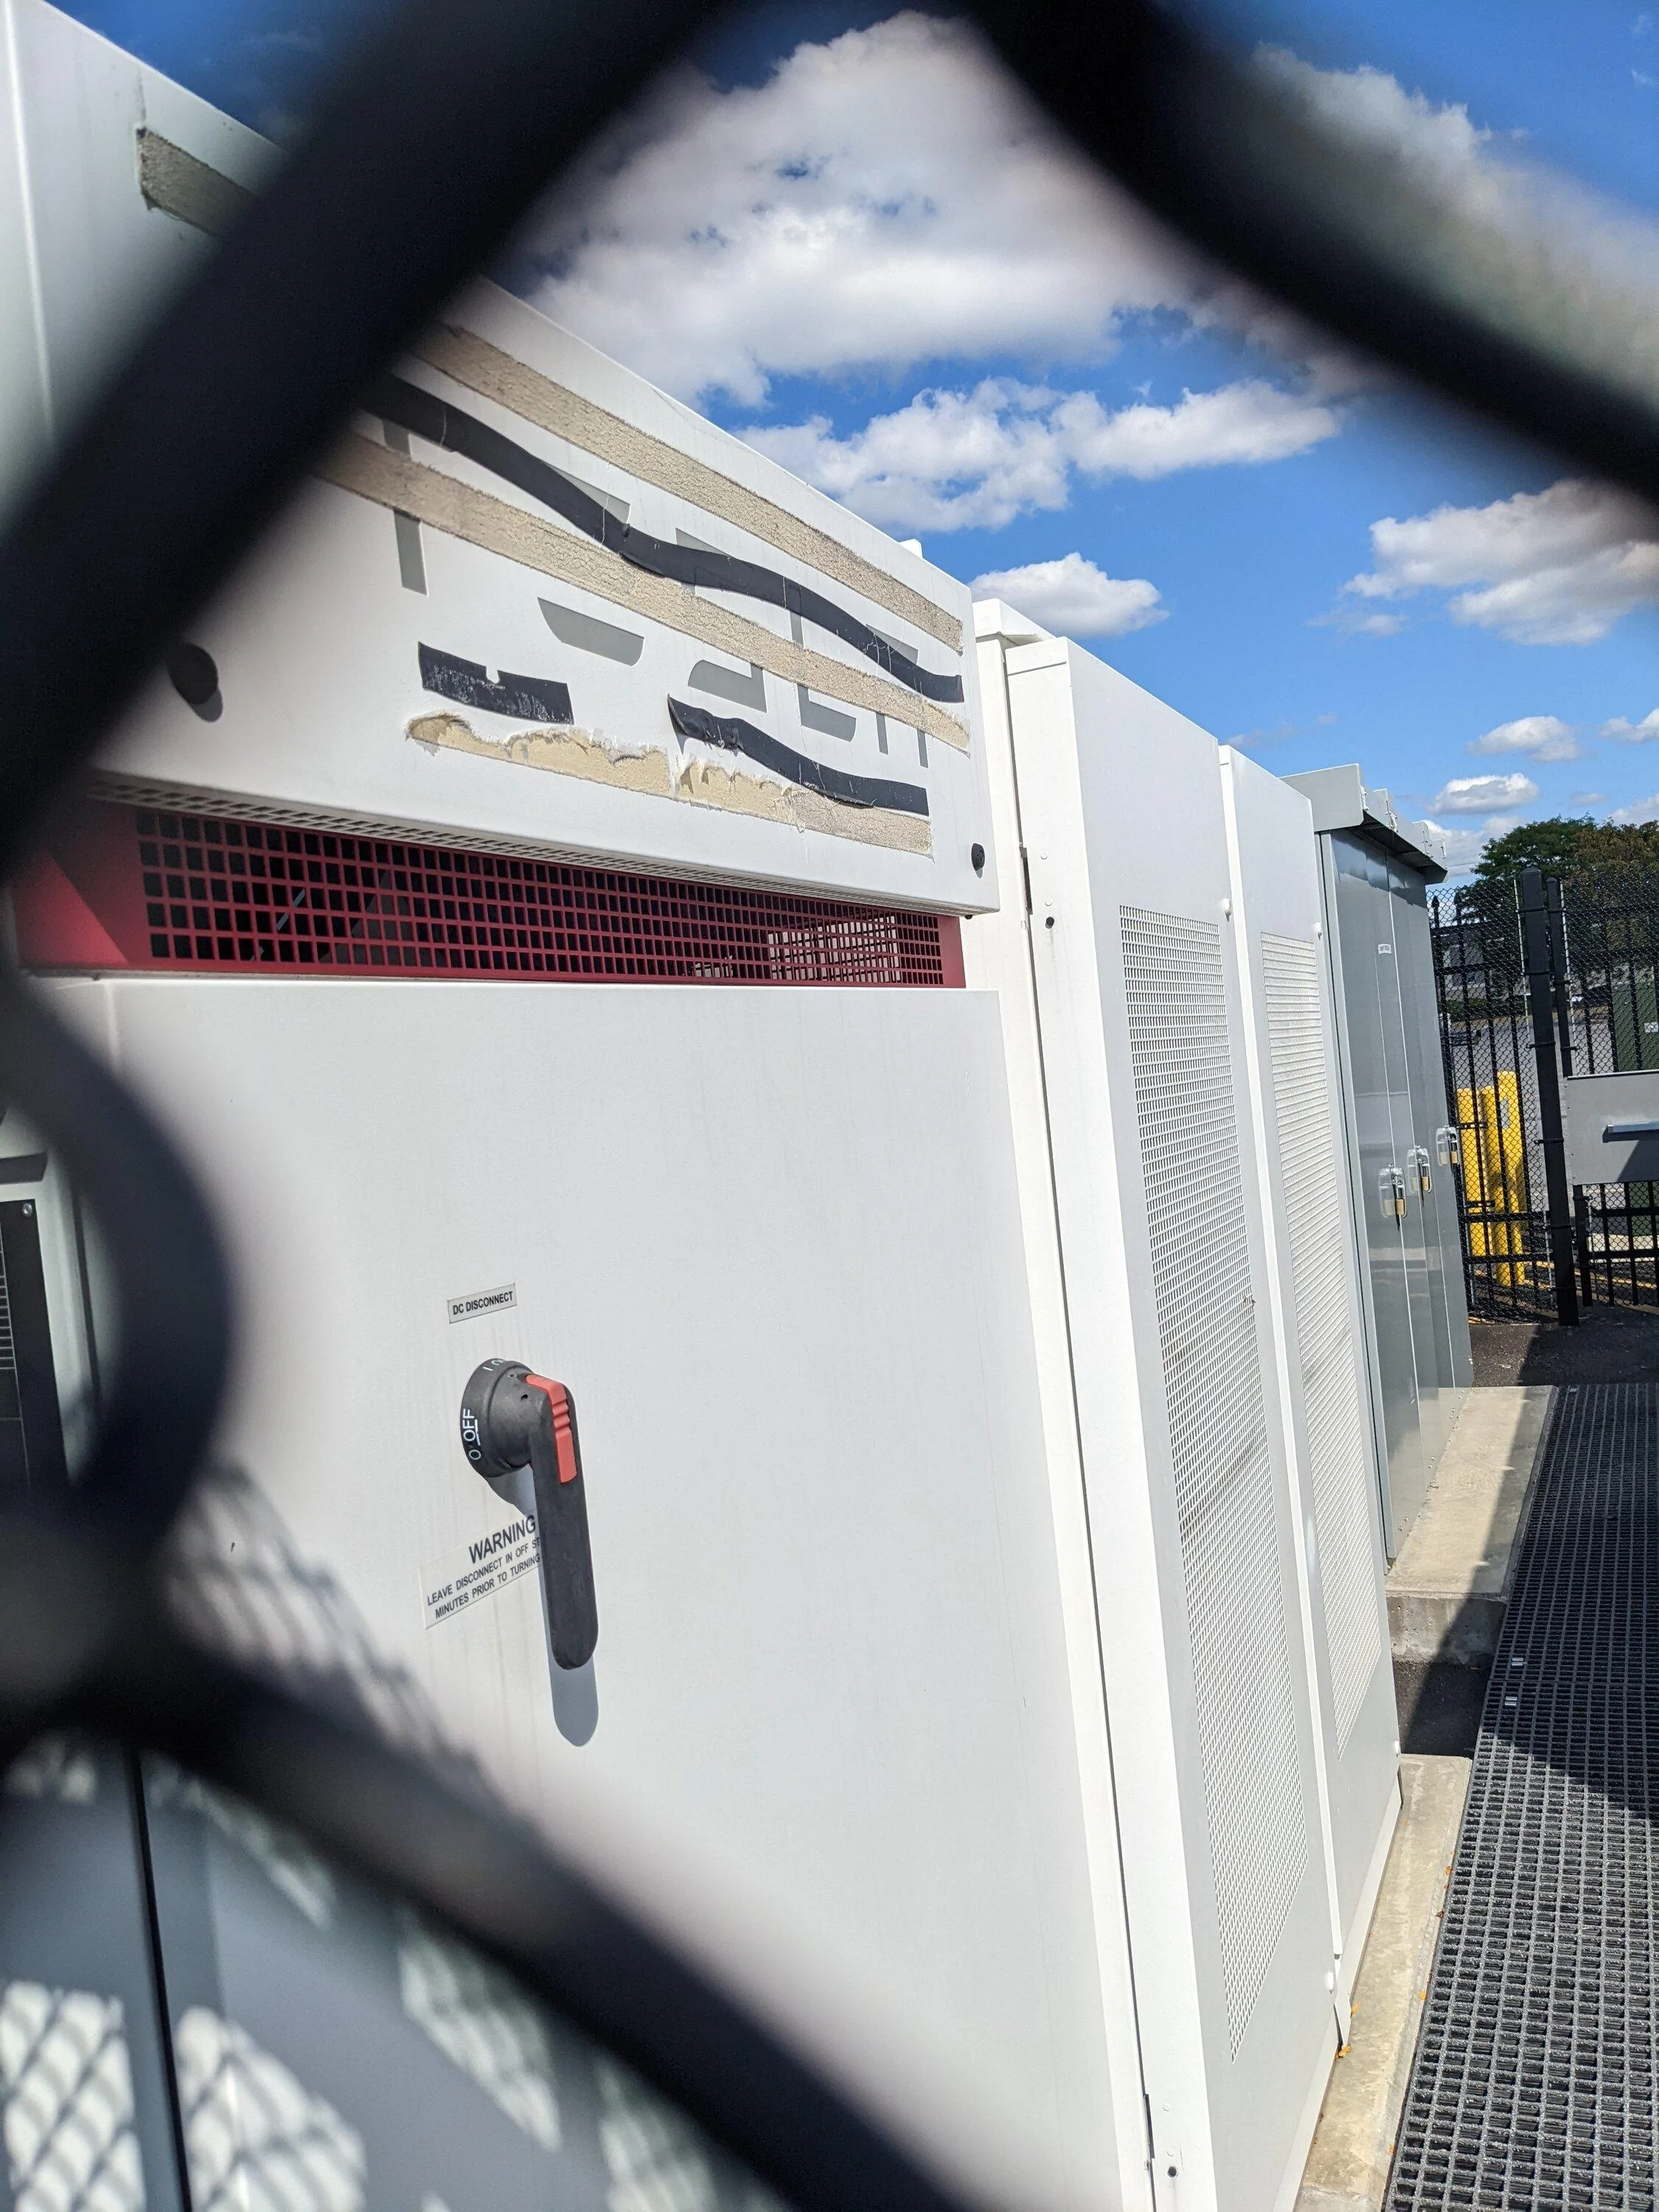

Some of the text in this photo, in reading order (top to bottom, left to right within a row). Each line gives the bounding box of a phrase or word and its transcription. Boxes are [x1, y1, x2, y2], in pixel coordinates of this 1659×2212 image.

[453, 1291, 513, 1315] DC DISCONNECT
[462, 1408, 476, 1441] OFF
[468, 1514, 536, 1564] WARNING
[427, 1584, 453, 1606] LEAVE
[456, 1557, 503, 1590] DISCONNECT
[505, 1552, 513, 1563] IN
[515, 1543, 529, 1557] OFF
[435, 1553, 540, 1619] MINUTES PRIOR TO TURNING
